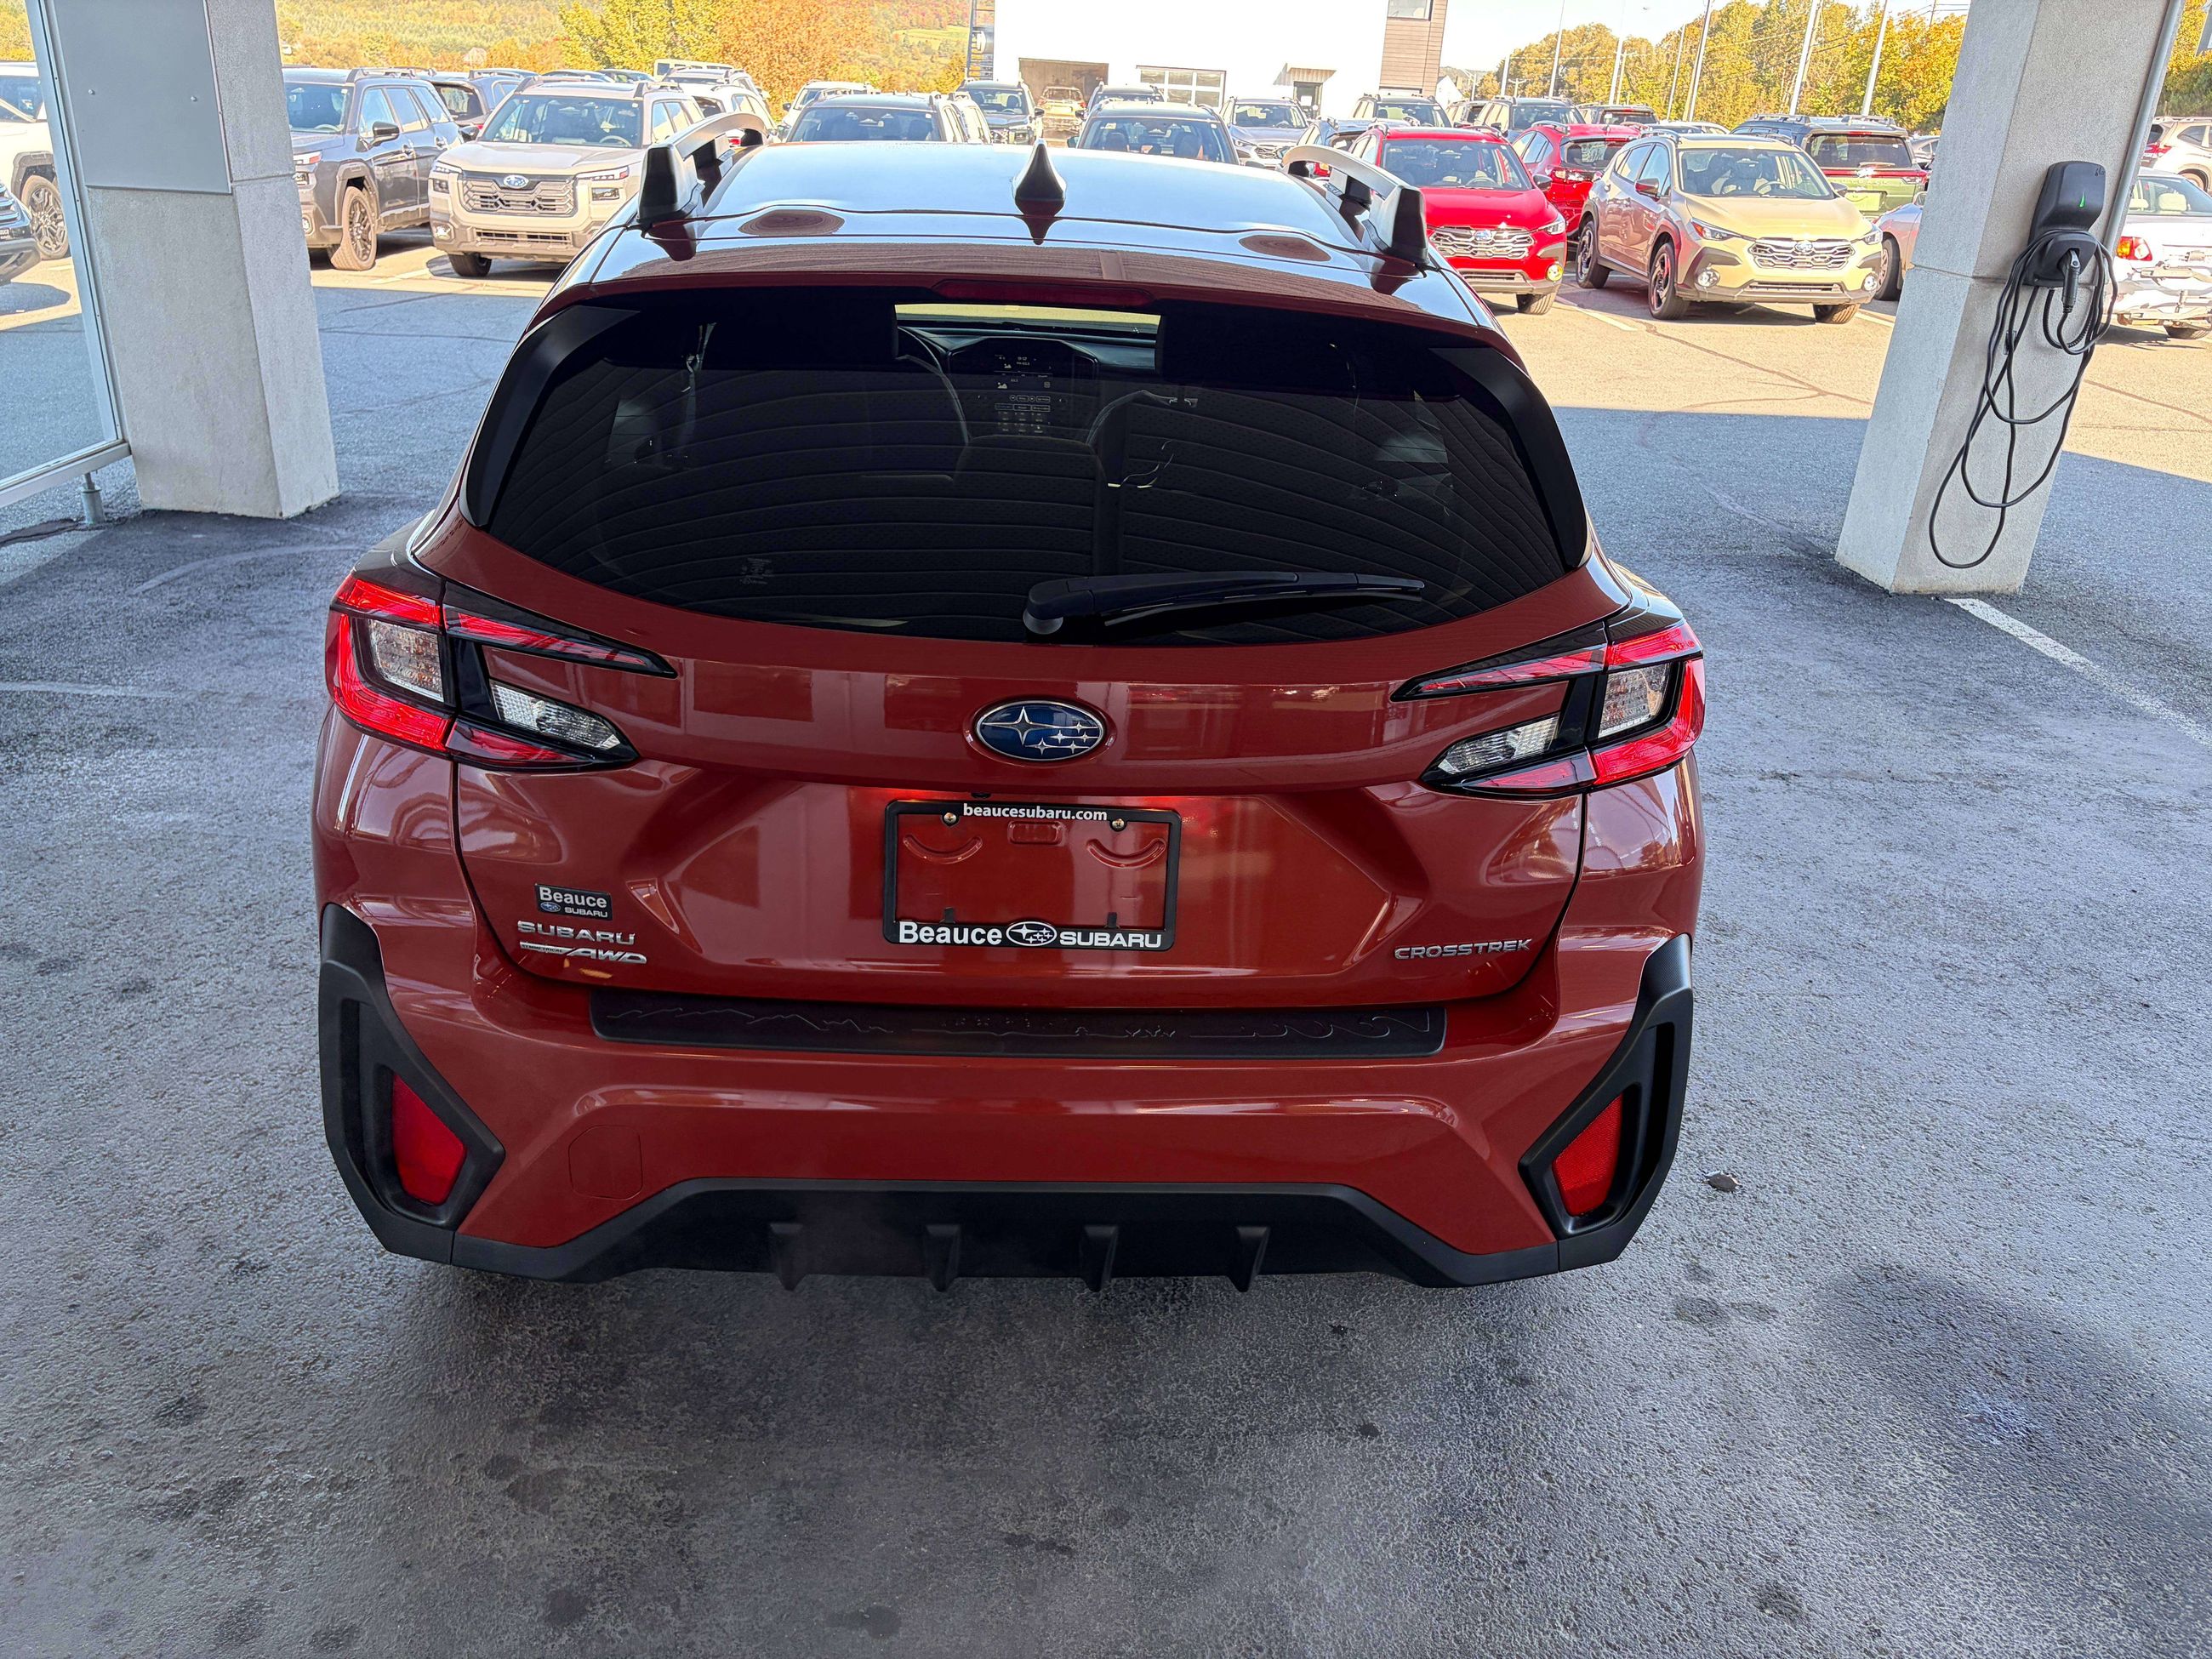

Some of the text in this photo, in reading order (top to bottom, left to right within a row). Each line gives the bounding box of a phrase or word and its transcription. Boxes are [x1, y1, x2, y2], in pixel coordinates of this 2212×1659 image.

[963, 803, 1108, 821] beaucesubaru.com
[539, 887, 607, 909] Beauce
[564, 906, 608, 918] SUBARU
[517, 920, 636, 945] SUBARU
[898, 921, 1162, 949] Beauce SUBARU
[522, 944, 647, 965] SYMMETRICAL AWD
[1394, 938, 1532, 960] CROSSTREK
